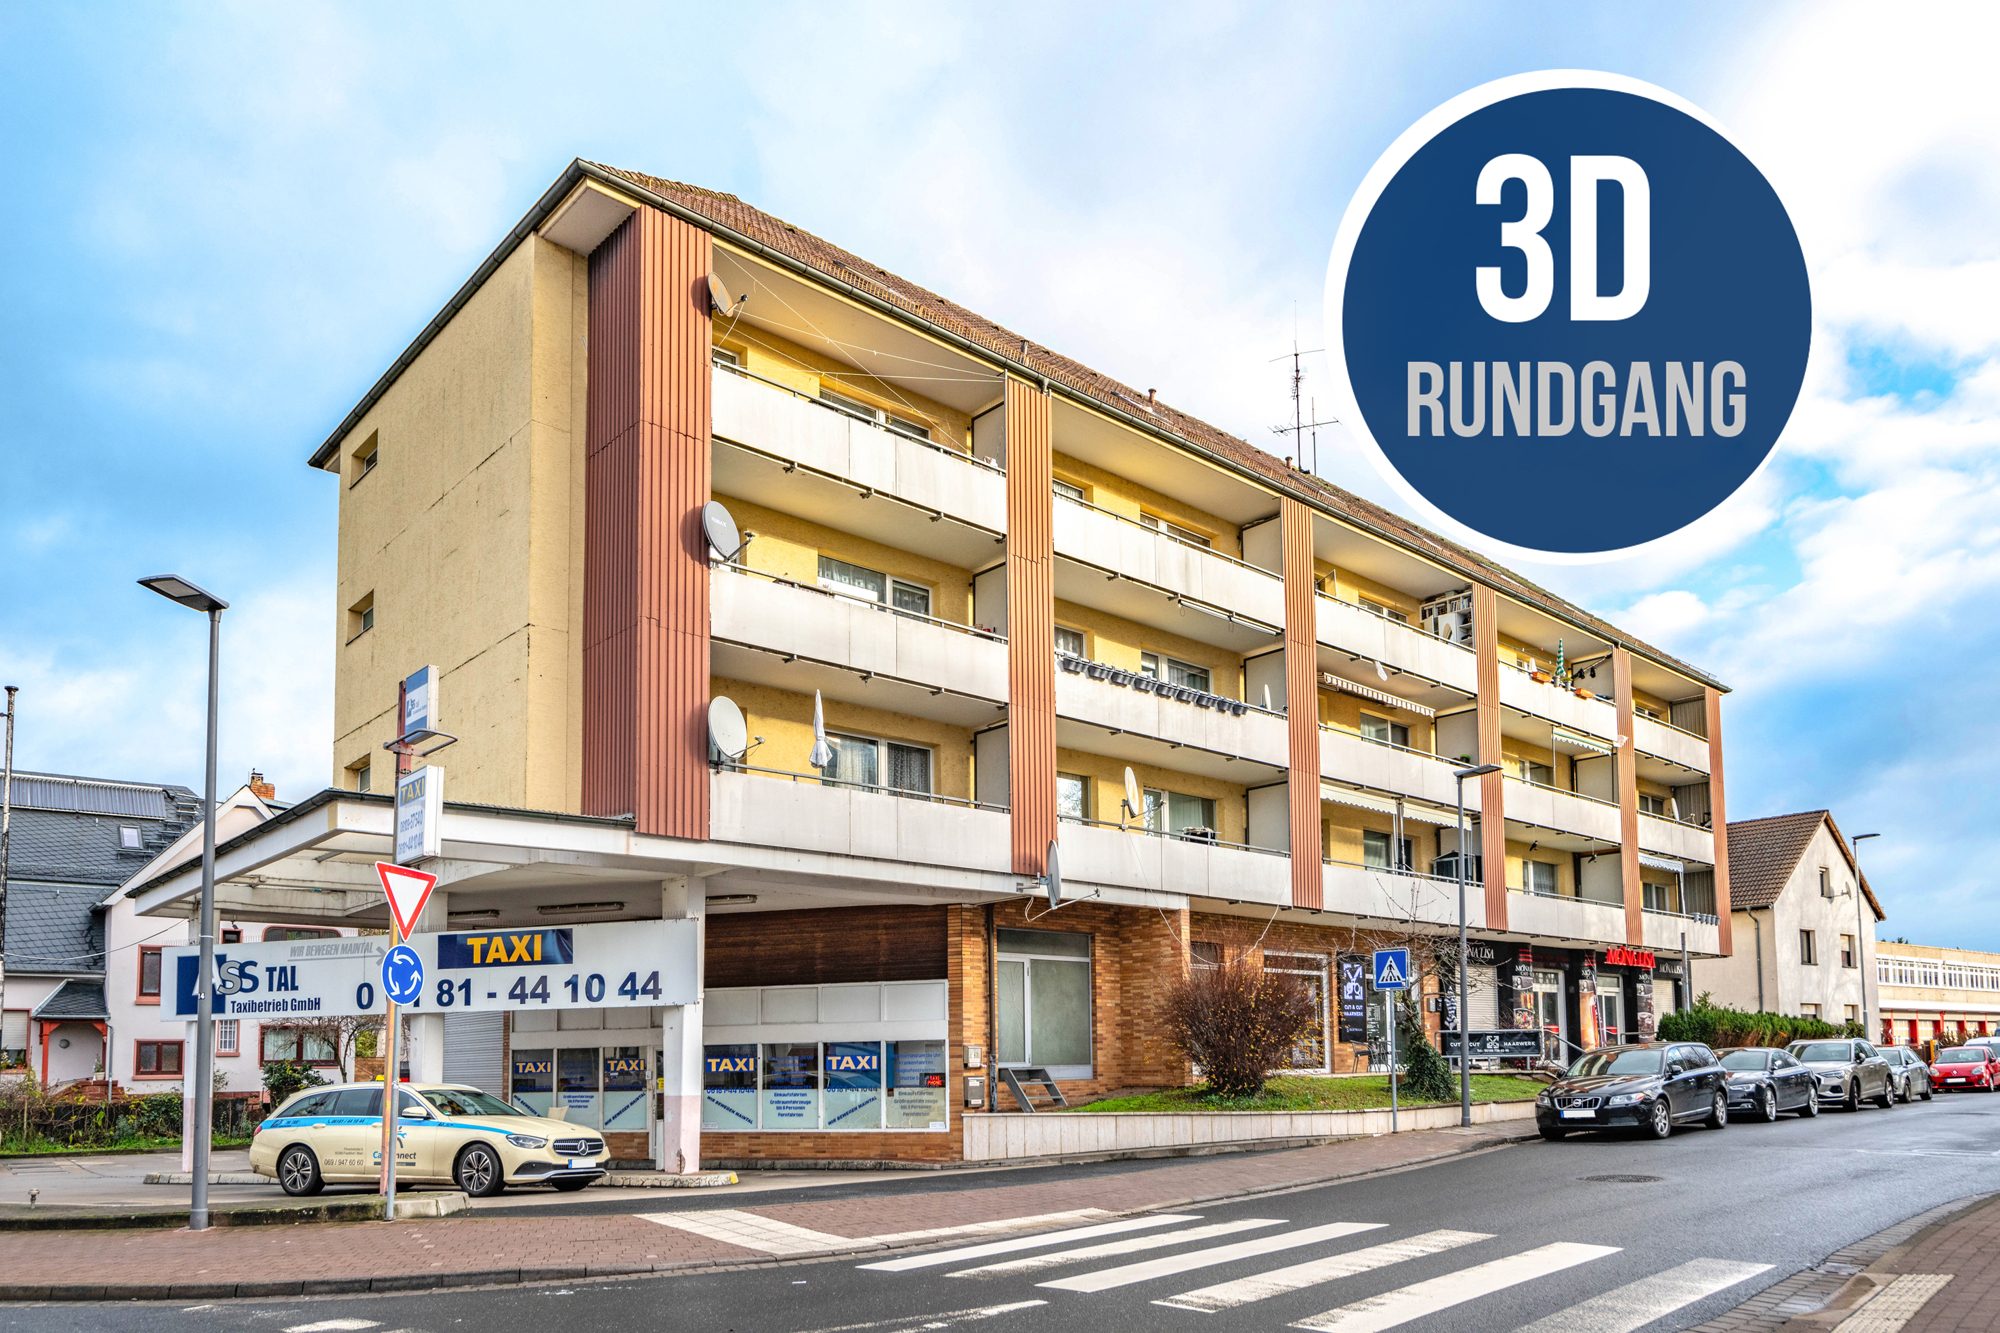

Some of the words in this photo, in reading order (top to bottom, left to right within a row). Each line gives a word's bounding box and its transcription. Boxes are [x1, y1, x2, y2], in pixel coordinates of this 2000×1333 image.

[401, 777, 425, 803] TAXI
[290, 946, 304, 958] WIR
[306, 944, 340, 957] BEWEGEN
[340, 942, 372, 955] MAINTAL
[467, 934, 542, 964] TAXI
[1479, 947, 1494, 960] LISA
[266, 965, 299, 992] TAL
[508, 976, 550, 1005] 44
[564, 973, 606, 1003] 10
[618, 970, 662, 1000] 44
[230, 998, 288, 1014] Taxibetrieb
[290, 997, 320, 1012] GmbH
[516, 1062, 551, 1073] TAXI
[608, 1060, 645, 1071] TAXI
[708, 1058, 754, 1072] TAXI
[828, 1056, 878, 1070] TAXI
[612, 1104, 630, 1120] BEWEGEN
[715, 1100, 736, 1114] BEWEGEN
[735, 1111, 753, 1124] MAINTAL
[837, 1108, 858, 1120] BEWEGEN
[858, 1096, 877, 1109] MAINTAL
[372, 1151, 416, 1160] Cannect
